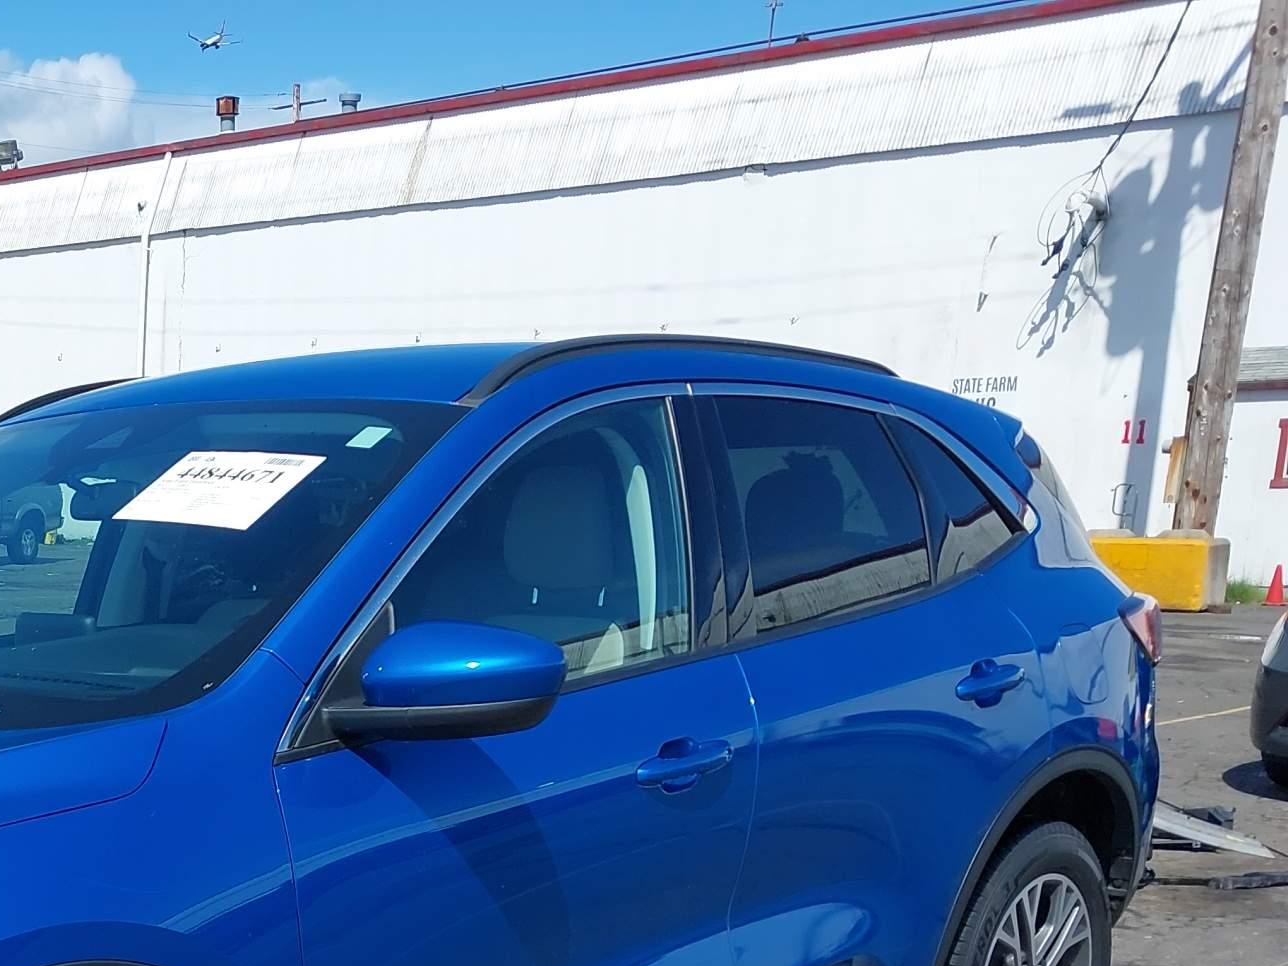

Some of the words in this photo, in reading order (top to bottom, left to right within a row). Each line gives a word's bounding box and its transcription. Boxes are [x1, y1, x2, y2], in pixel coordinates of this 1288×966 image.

[952, 377, 983, 395] STATE
[985, 375, 1018, 393] FARM
[1121, 418, 1146, 445] 11
[176, 466, 285, 485] 44844671
